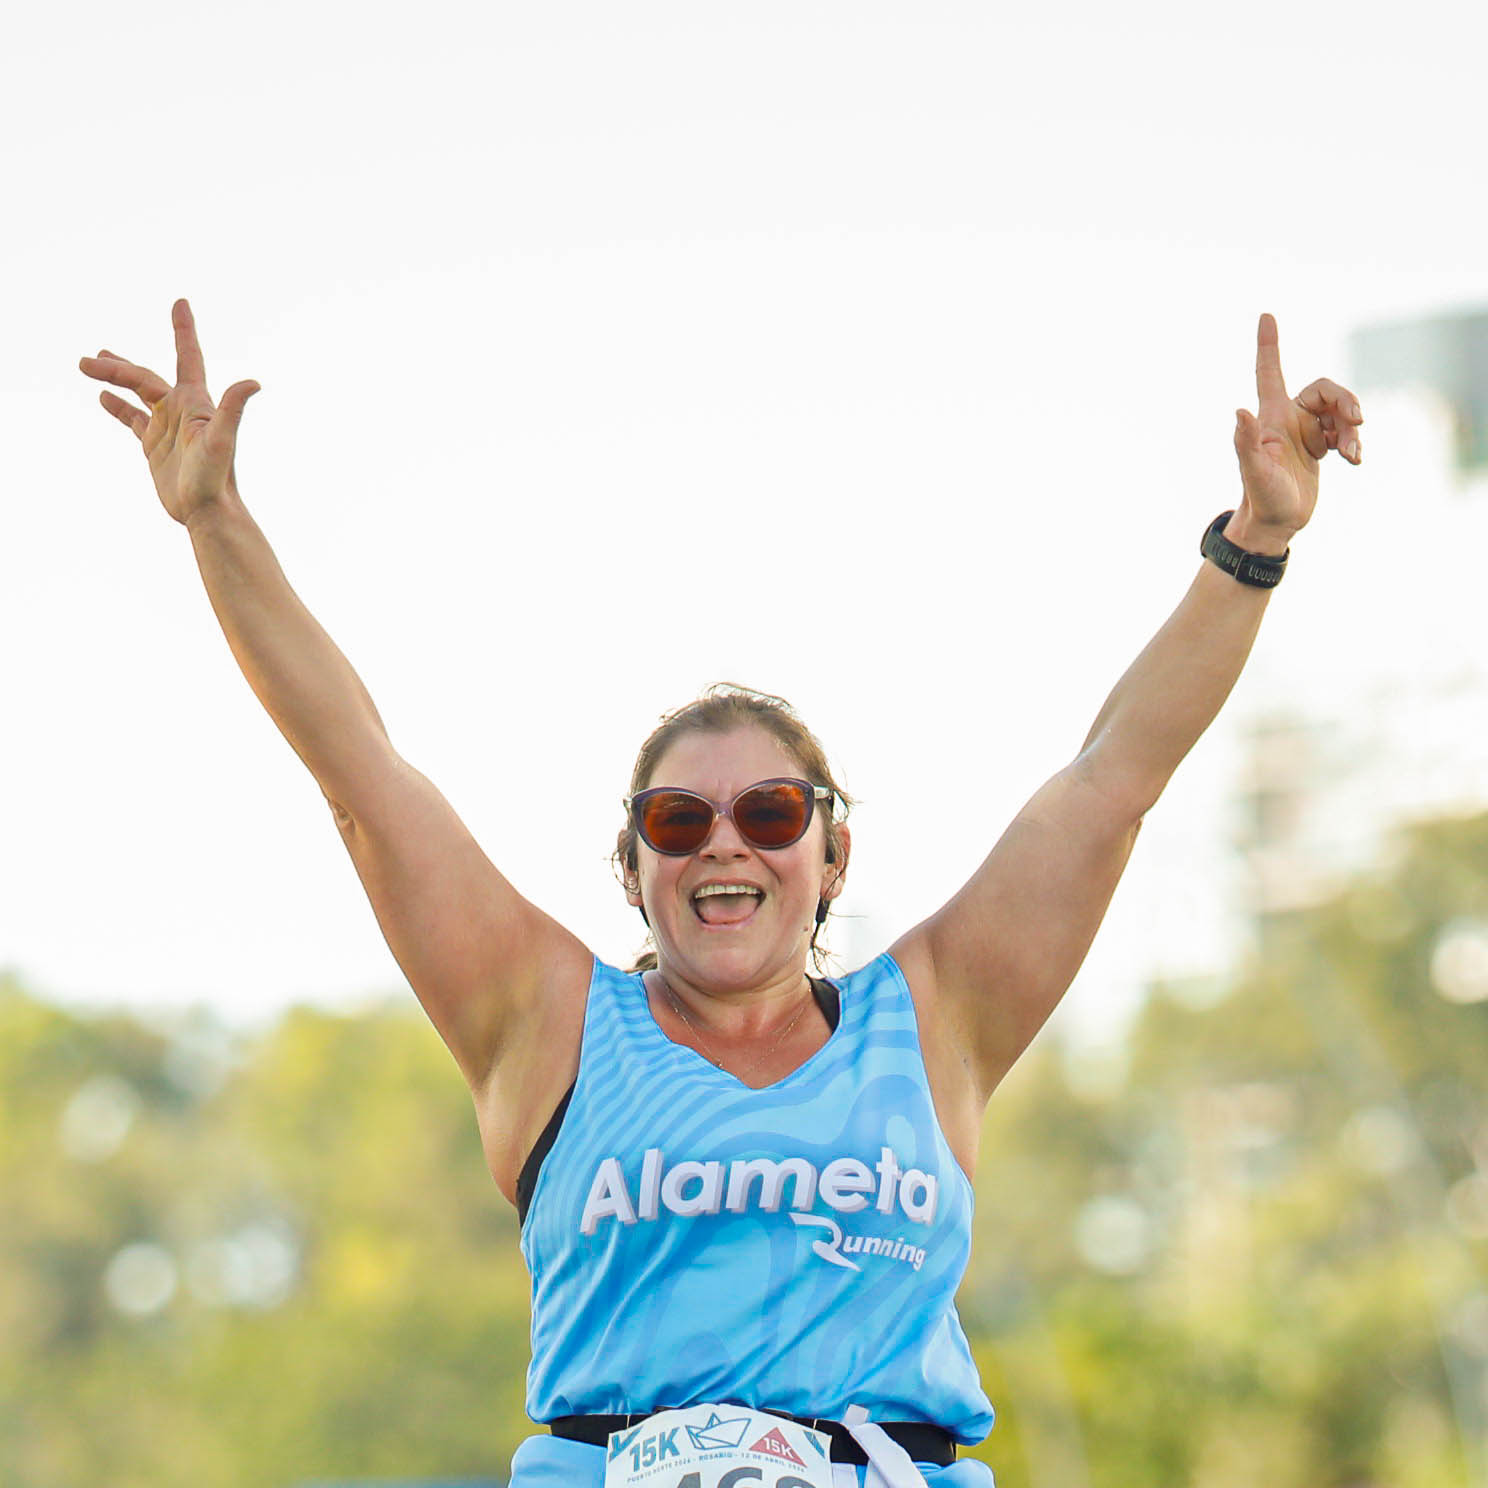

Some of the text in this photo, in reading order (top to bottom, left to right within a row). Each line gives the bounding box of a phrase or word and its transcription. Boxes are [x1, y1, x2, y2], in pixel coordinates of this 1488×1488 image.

[579, 1147, 938, 1236] Alameta
[788, 1211, 928, 1273] Running
[629, 1427, 680, 1472] 15K
[763, 1437, 794, 1458] 15K
